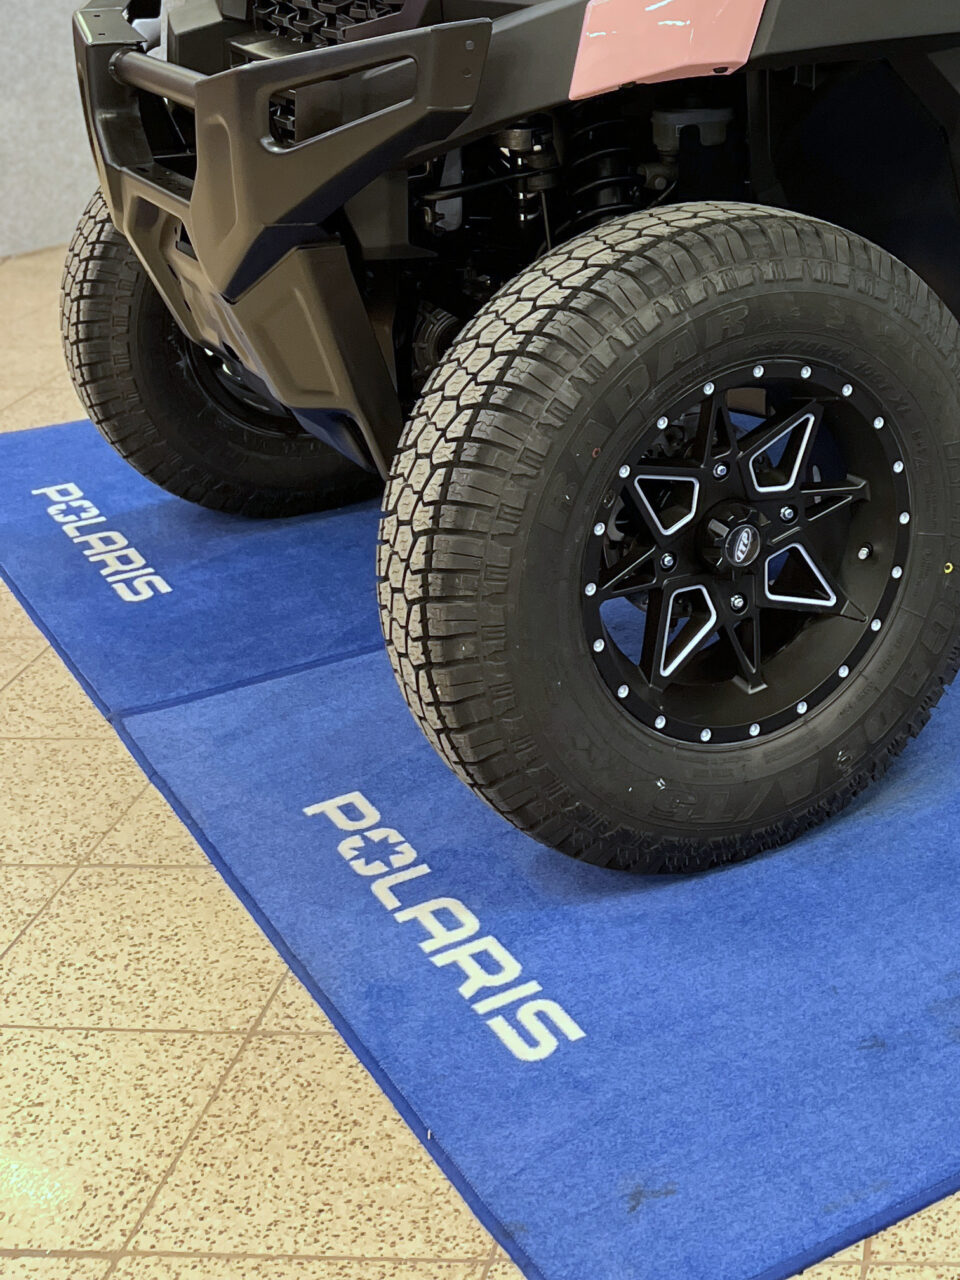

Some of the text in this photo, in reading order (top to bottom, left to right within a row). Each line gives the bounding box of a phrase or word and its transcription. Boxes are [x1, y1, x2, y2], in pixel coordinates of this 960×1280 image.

[32, 482, 172, 603] POLARIS
[735, 528, 752, 562] ITP
[304, 791, 586, 1062] POLARIS
